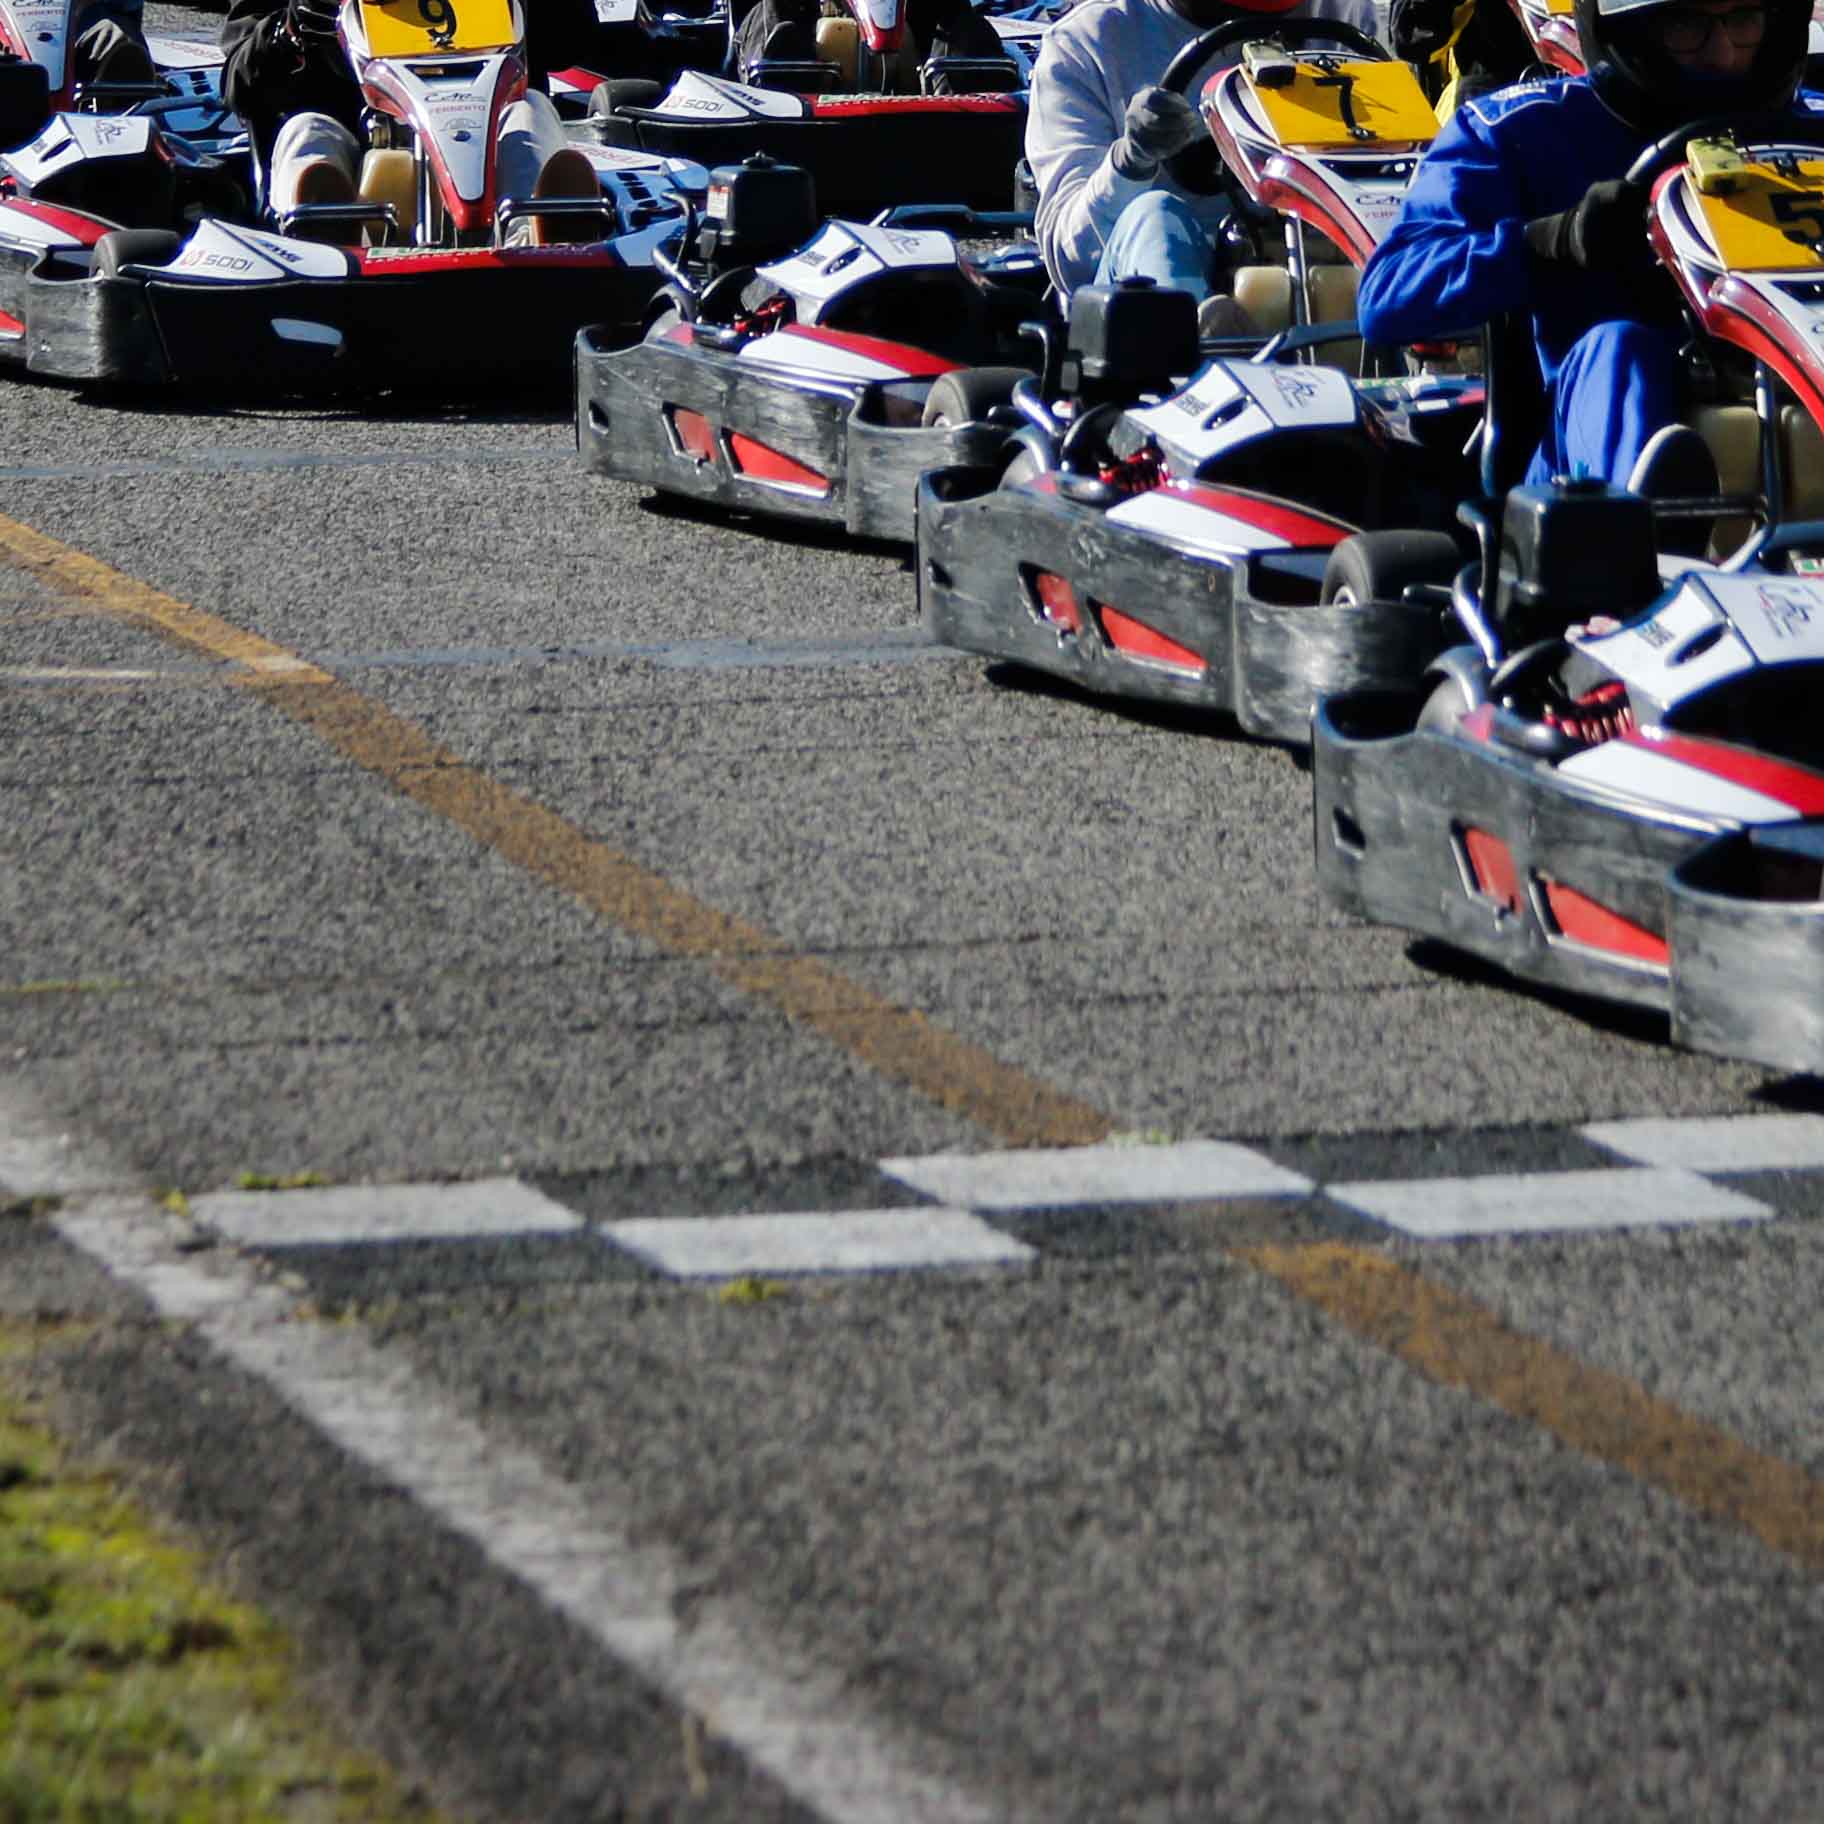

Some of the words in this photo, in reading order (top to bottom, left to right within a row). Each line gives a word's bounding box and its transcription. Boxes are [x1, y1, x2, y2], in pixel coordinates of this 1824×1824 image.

[684, 98, 725, 113] SODI
[1311, 76, 1355, 134] 7
[203, 254, 253, 272] SODI
